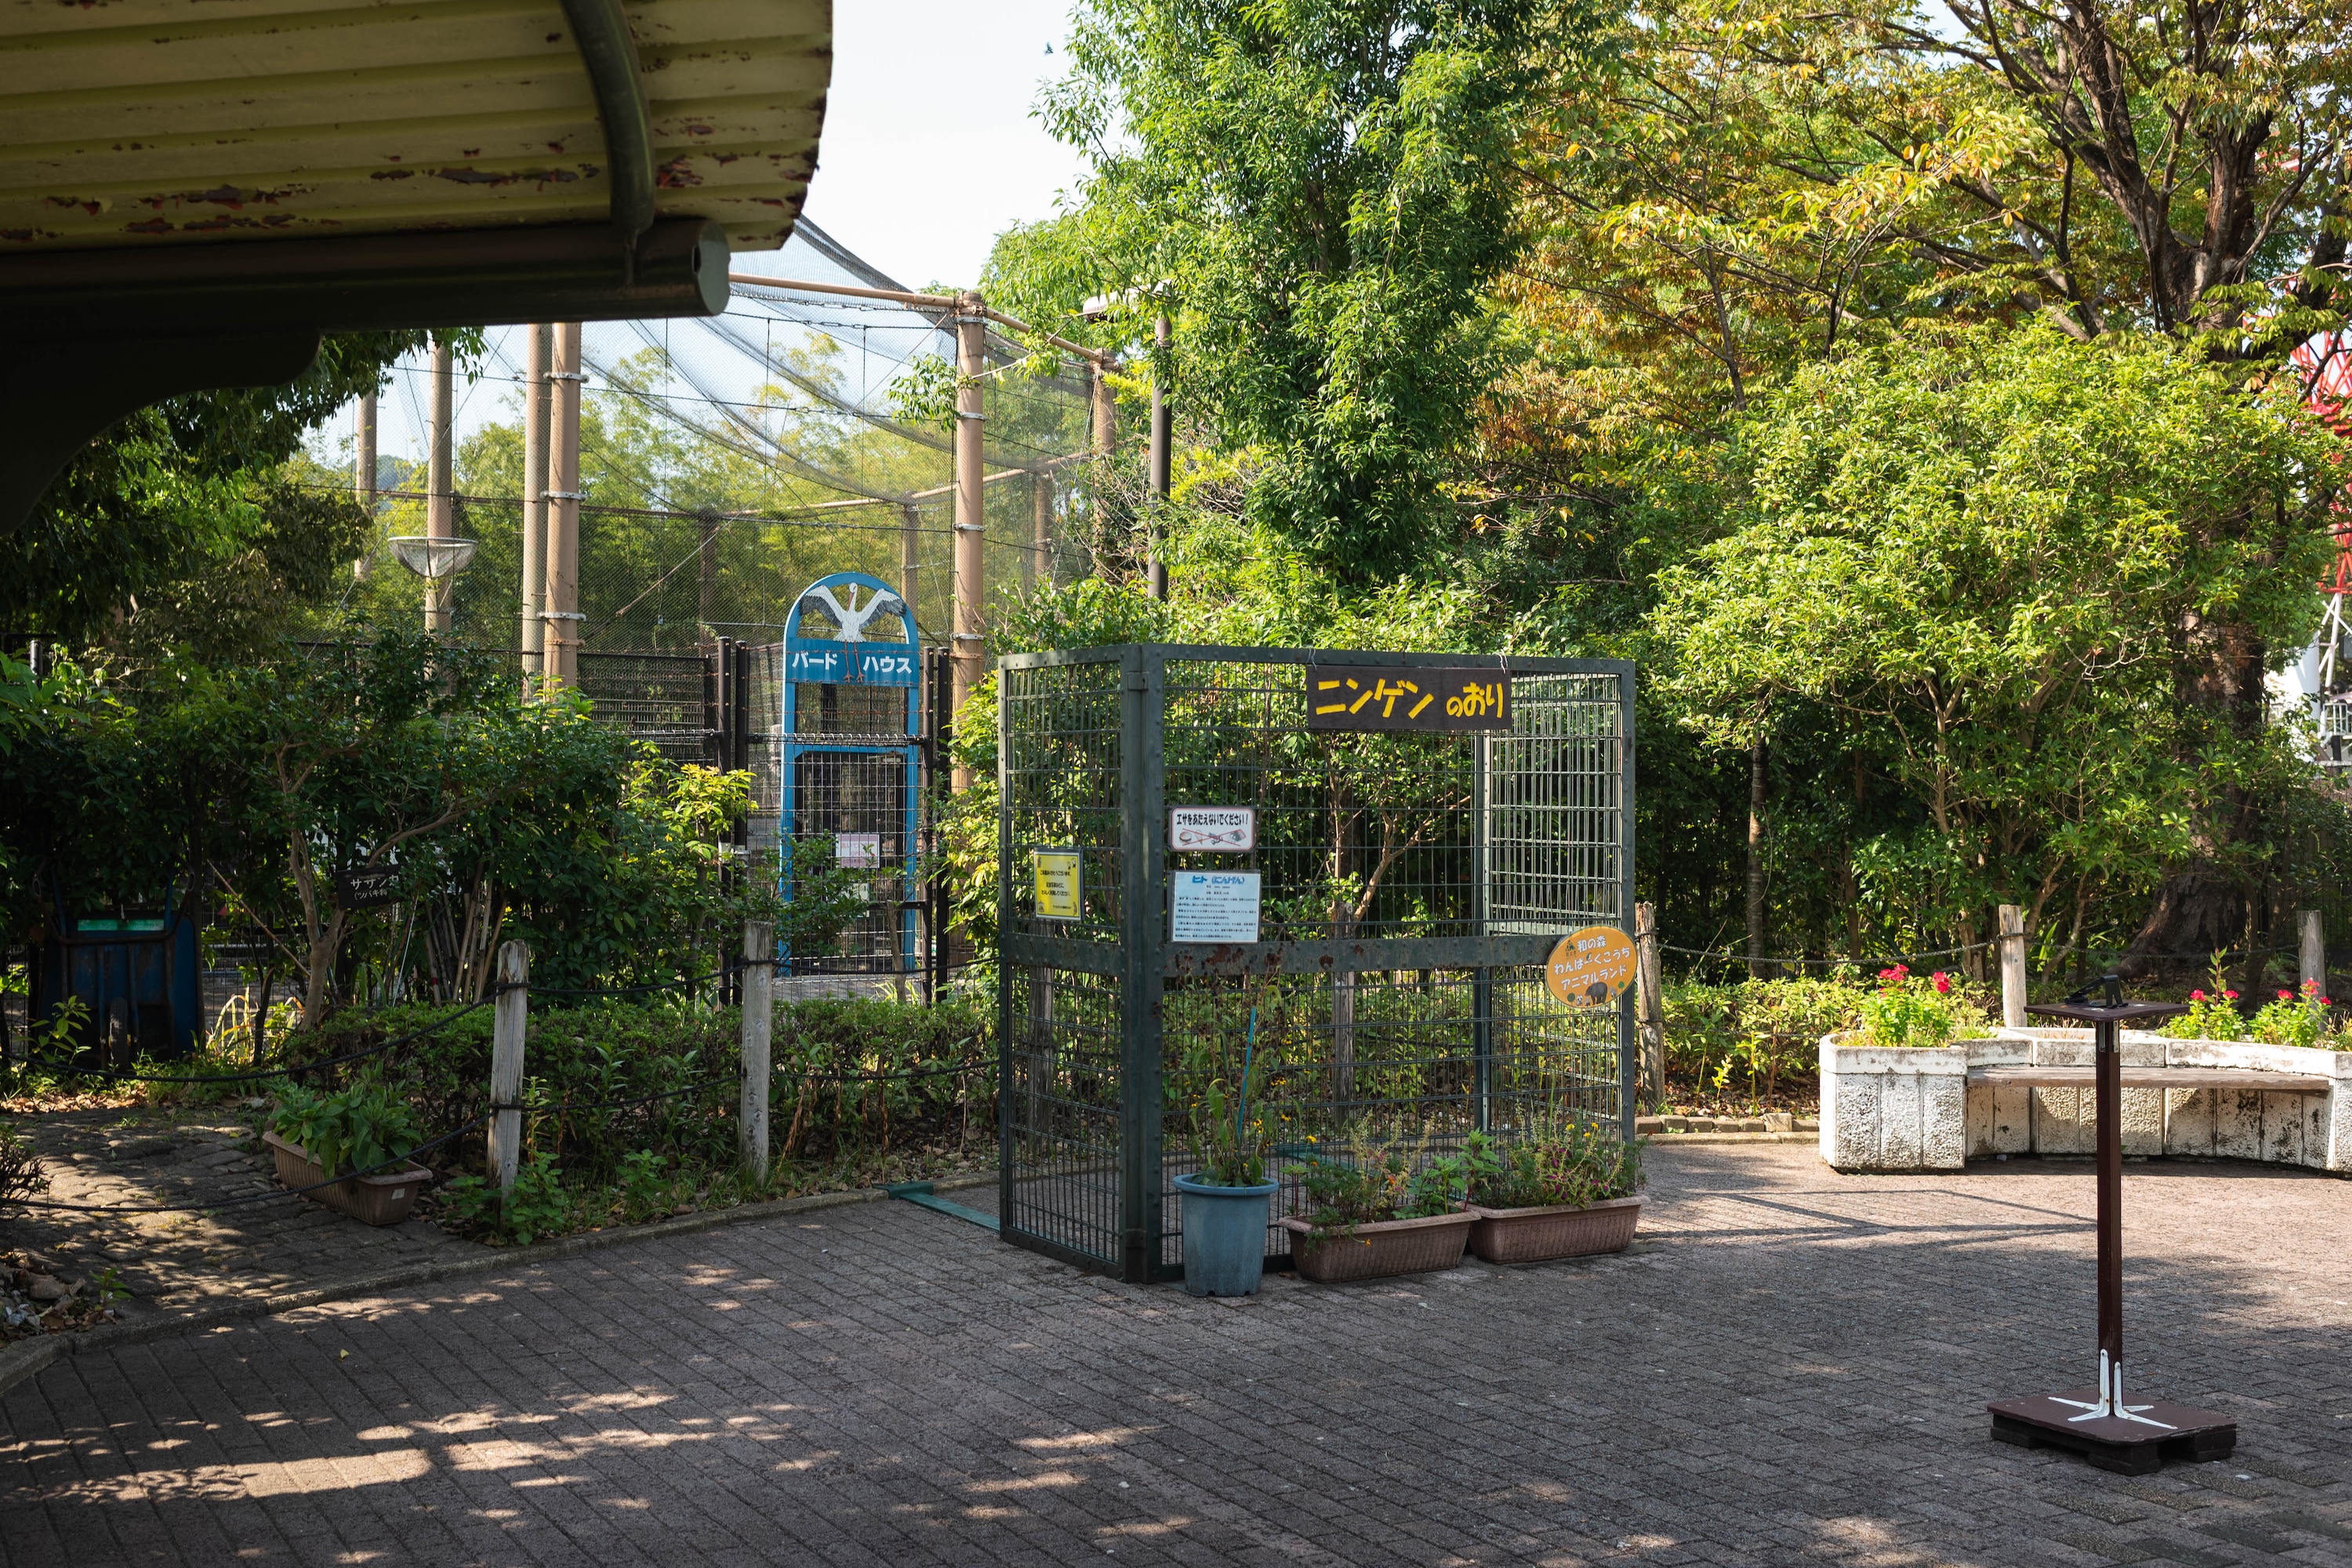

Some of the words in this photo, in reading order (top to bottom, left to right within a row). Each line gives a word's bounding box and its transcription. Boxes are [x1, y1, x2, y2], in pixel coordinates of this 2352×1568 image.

[792, 652, 837, 670] バード
[862, 655, 912, 674] ハウス
[1316, 677, 1435, 720] ニンゲン
[1446, 681, 1504, 719] のおり
[1191, 875, 1208, 884] ヒト
[1577, 935, 1607, 953] 和の森
[1561, 964, 1628, 984] アニマルランド
